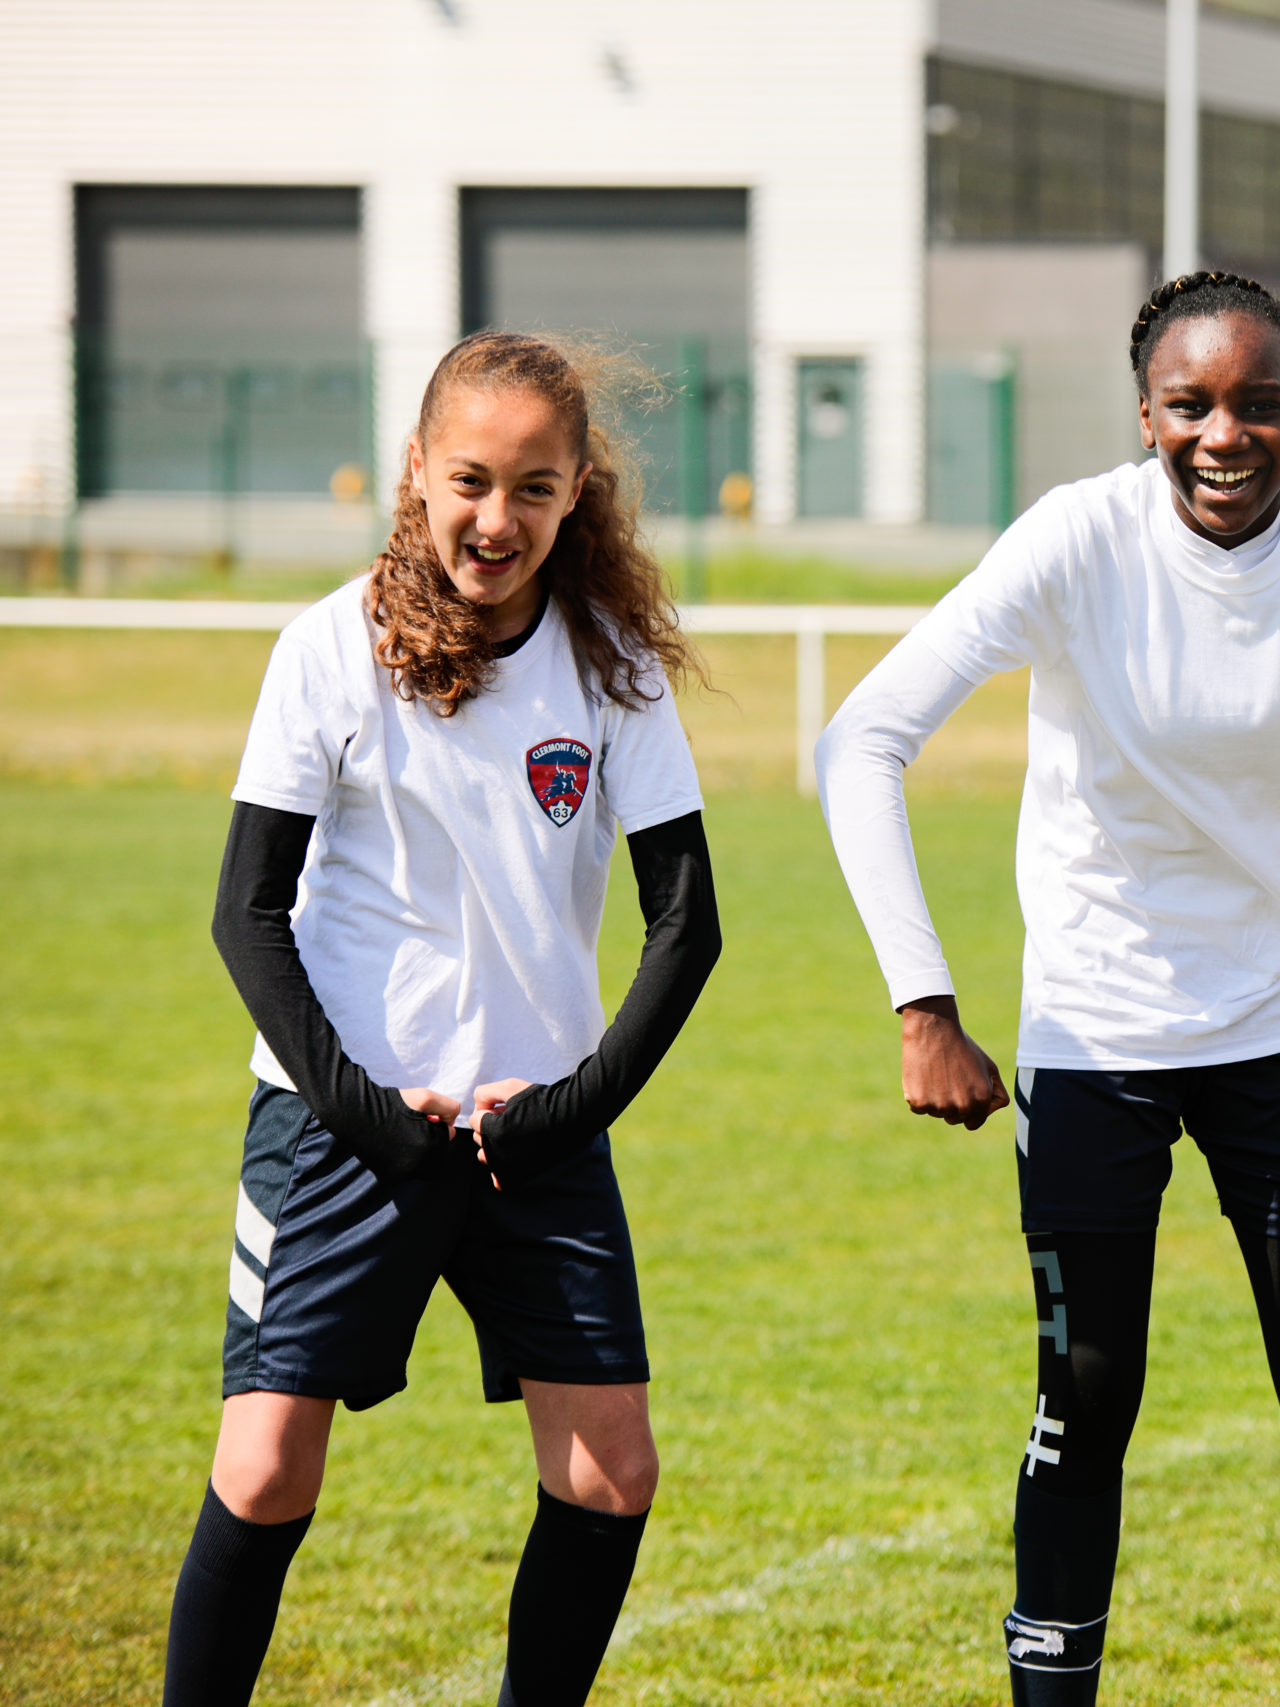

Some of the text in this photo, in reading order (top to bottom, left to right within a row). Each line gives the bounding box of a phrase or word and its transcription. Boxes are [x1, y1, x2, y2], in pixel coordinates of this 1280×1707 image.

[531, 742, 590, 760] CLERMONT FOOT
[553, 807, 569, 818] 63
